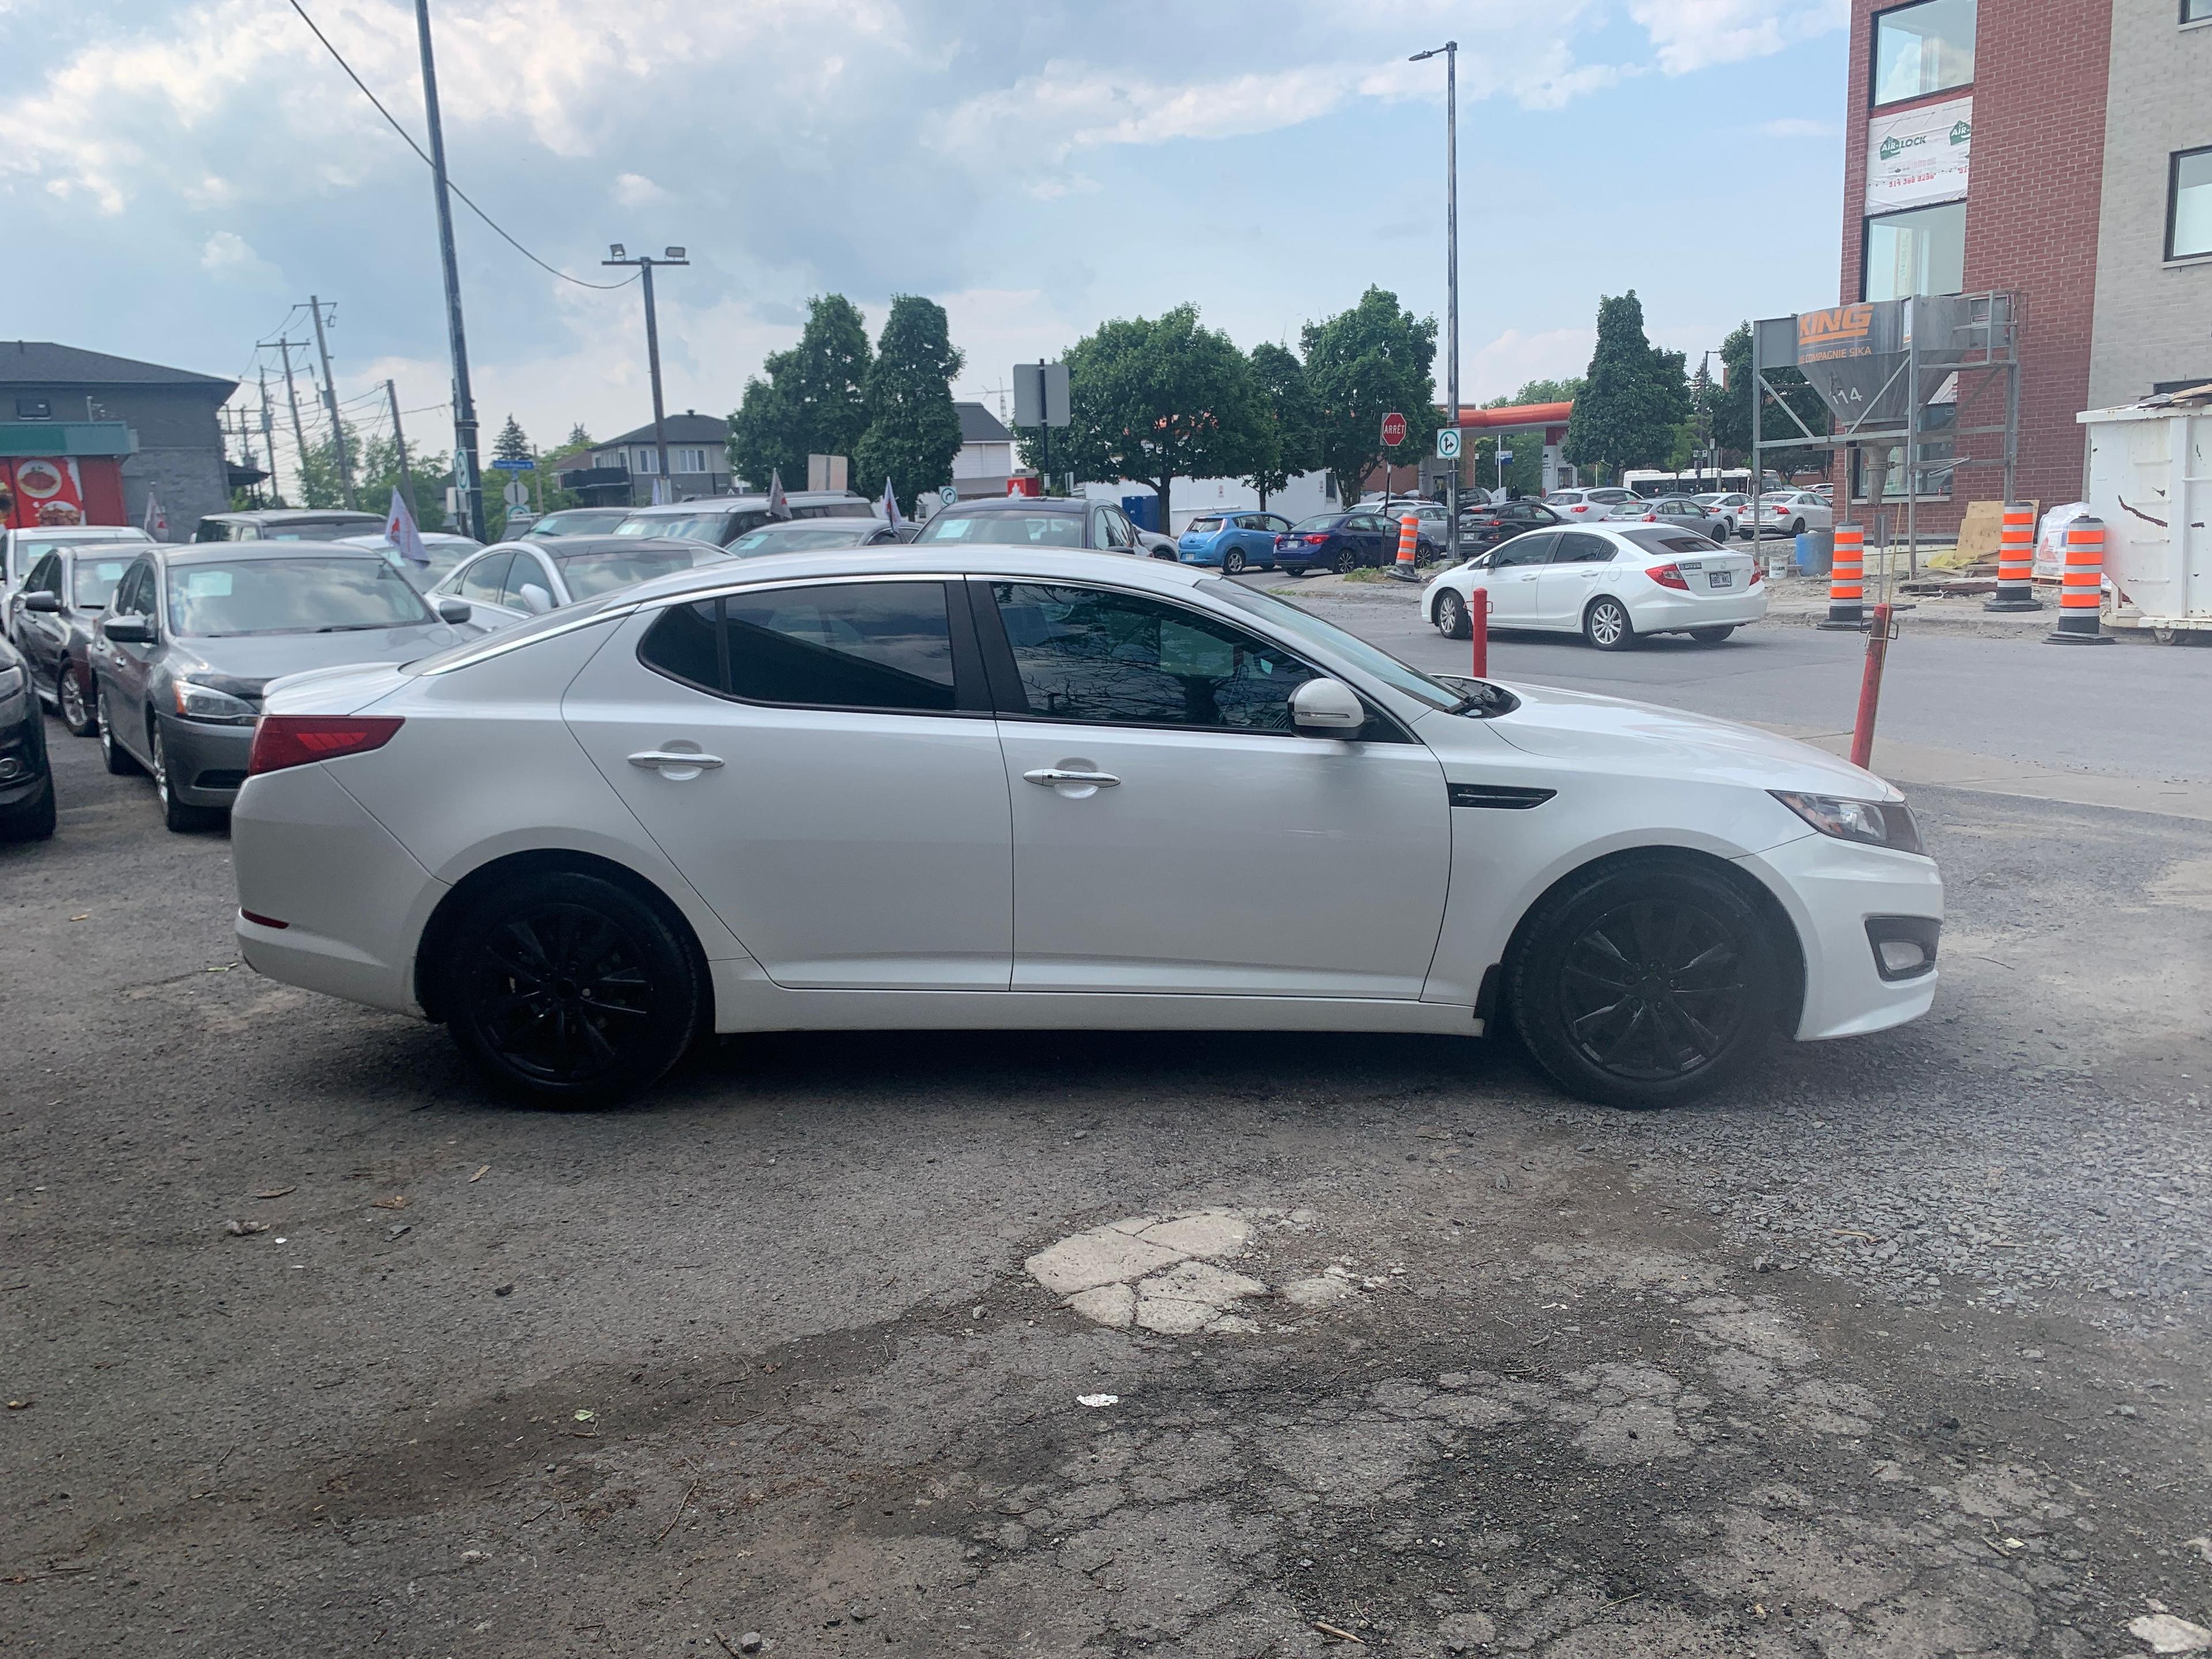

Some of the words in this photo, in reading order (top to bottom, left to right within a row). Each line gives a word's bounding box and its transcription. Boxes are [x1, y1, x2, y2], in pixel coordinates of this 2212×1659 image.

[1799, 305, 1874, 337] KING
[1805, 349, 1847, 363] COMPAGNIE
[1849, 346, 1872, 357] SIKA
[1384, 423, 1405, 434] ARRÊT
